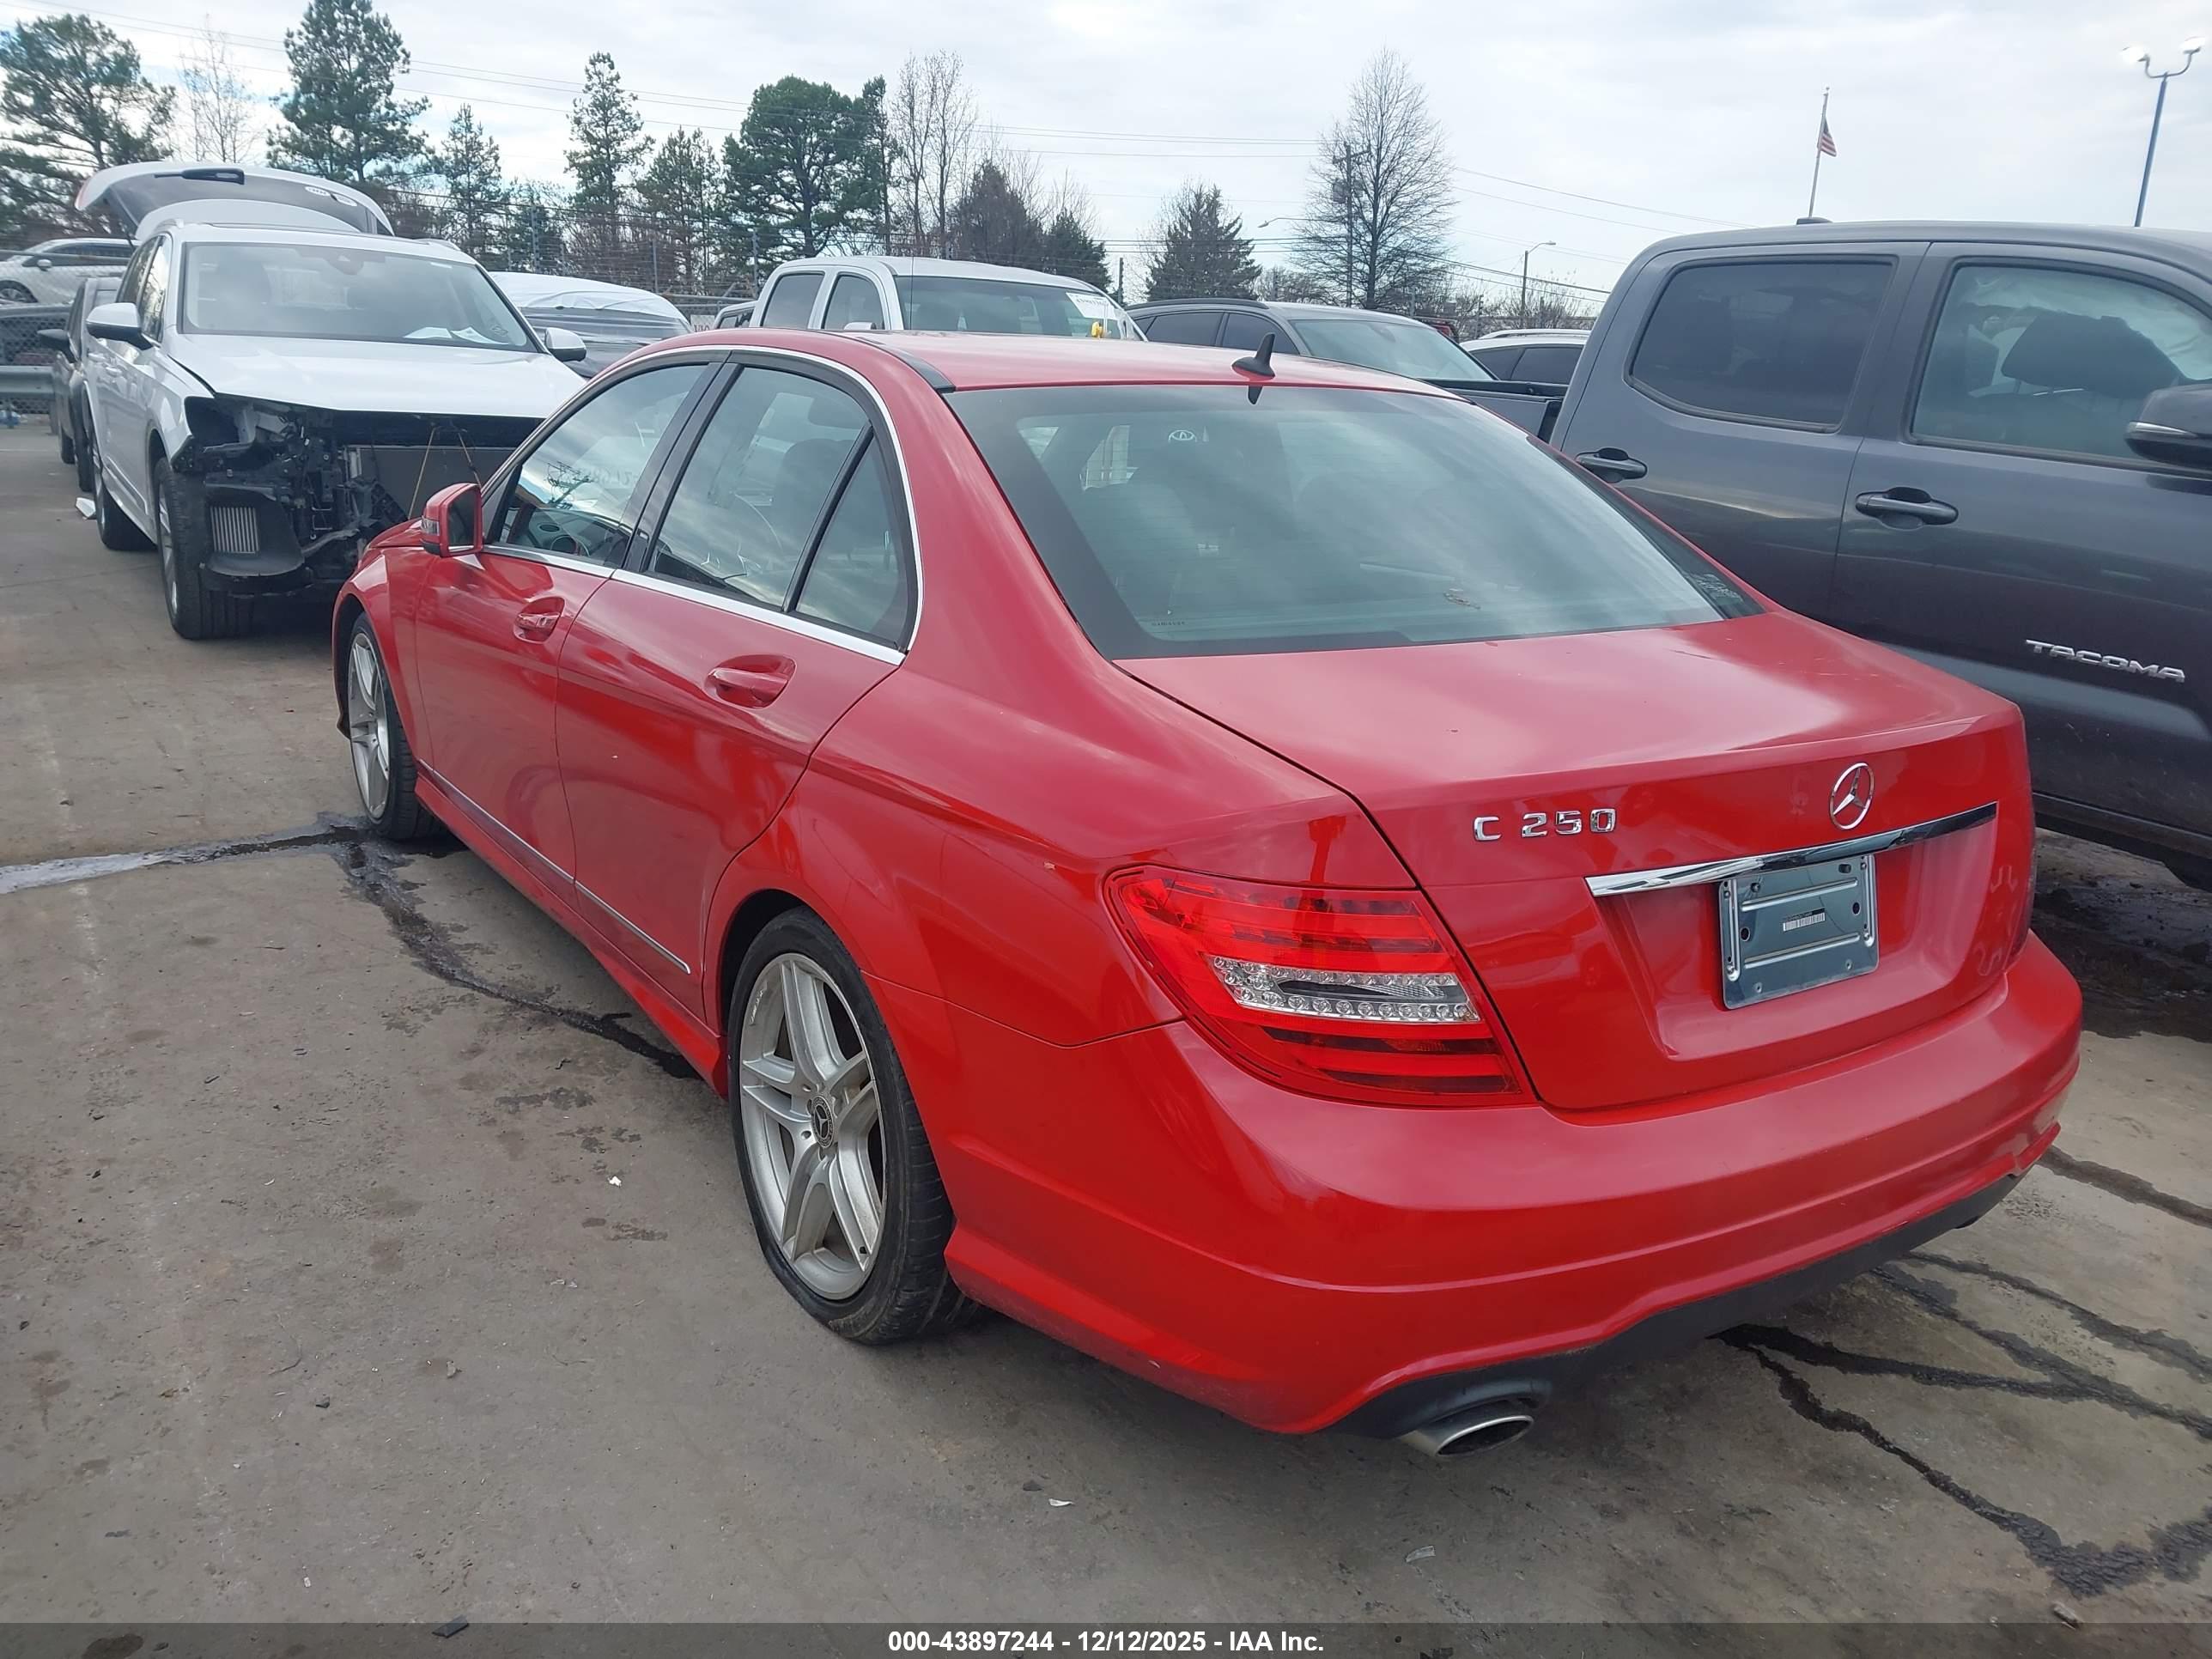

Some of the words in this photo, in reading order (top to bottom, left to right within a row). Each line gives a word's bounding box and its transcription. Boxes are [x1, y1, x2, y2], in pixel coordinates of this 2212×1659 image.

[2026, 639, 2185, 684] TACOMA
[1474, 816, 1502, 842] C
[1521, 808, 1617, 838] 250
